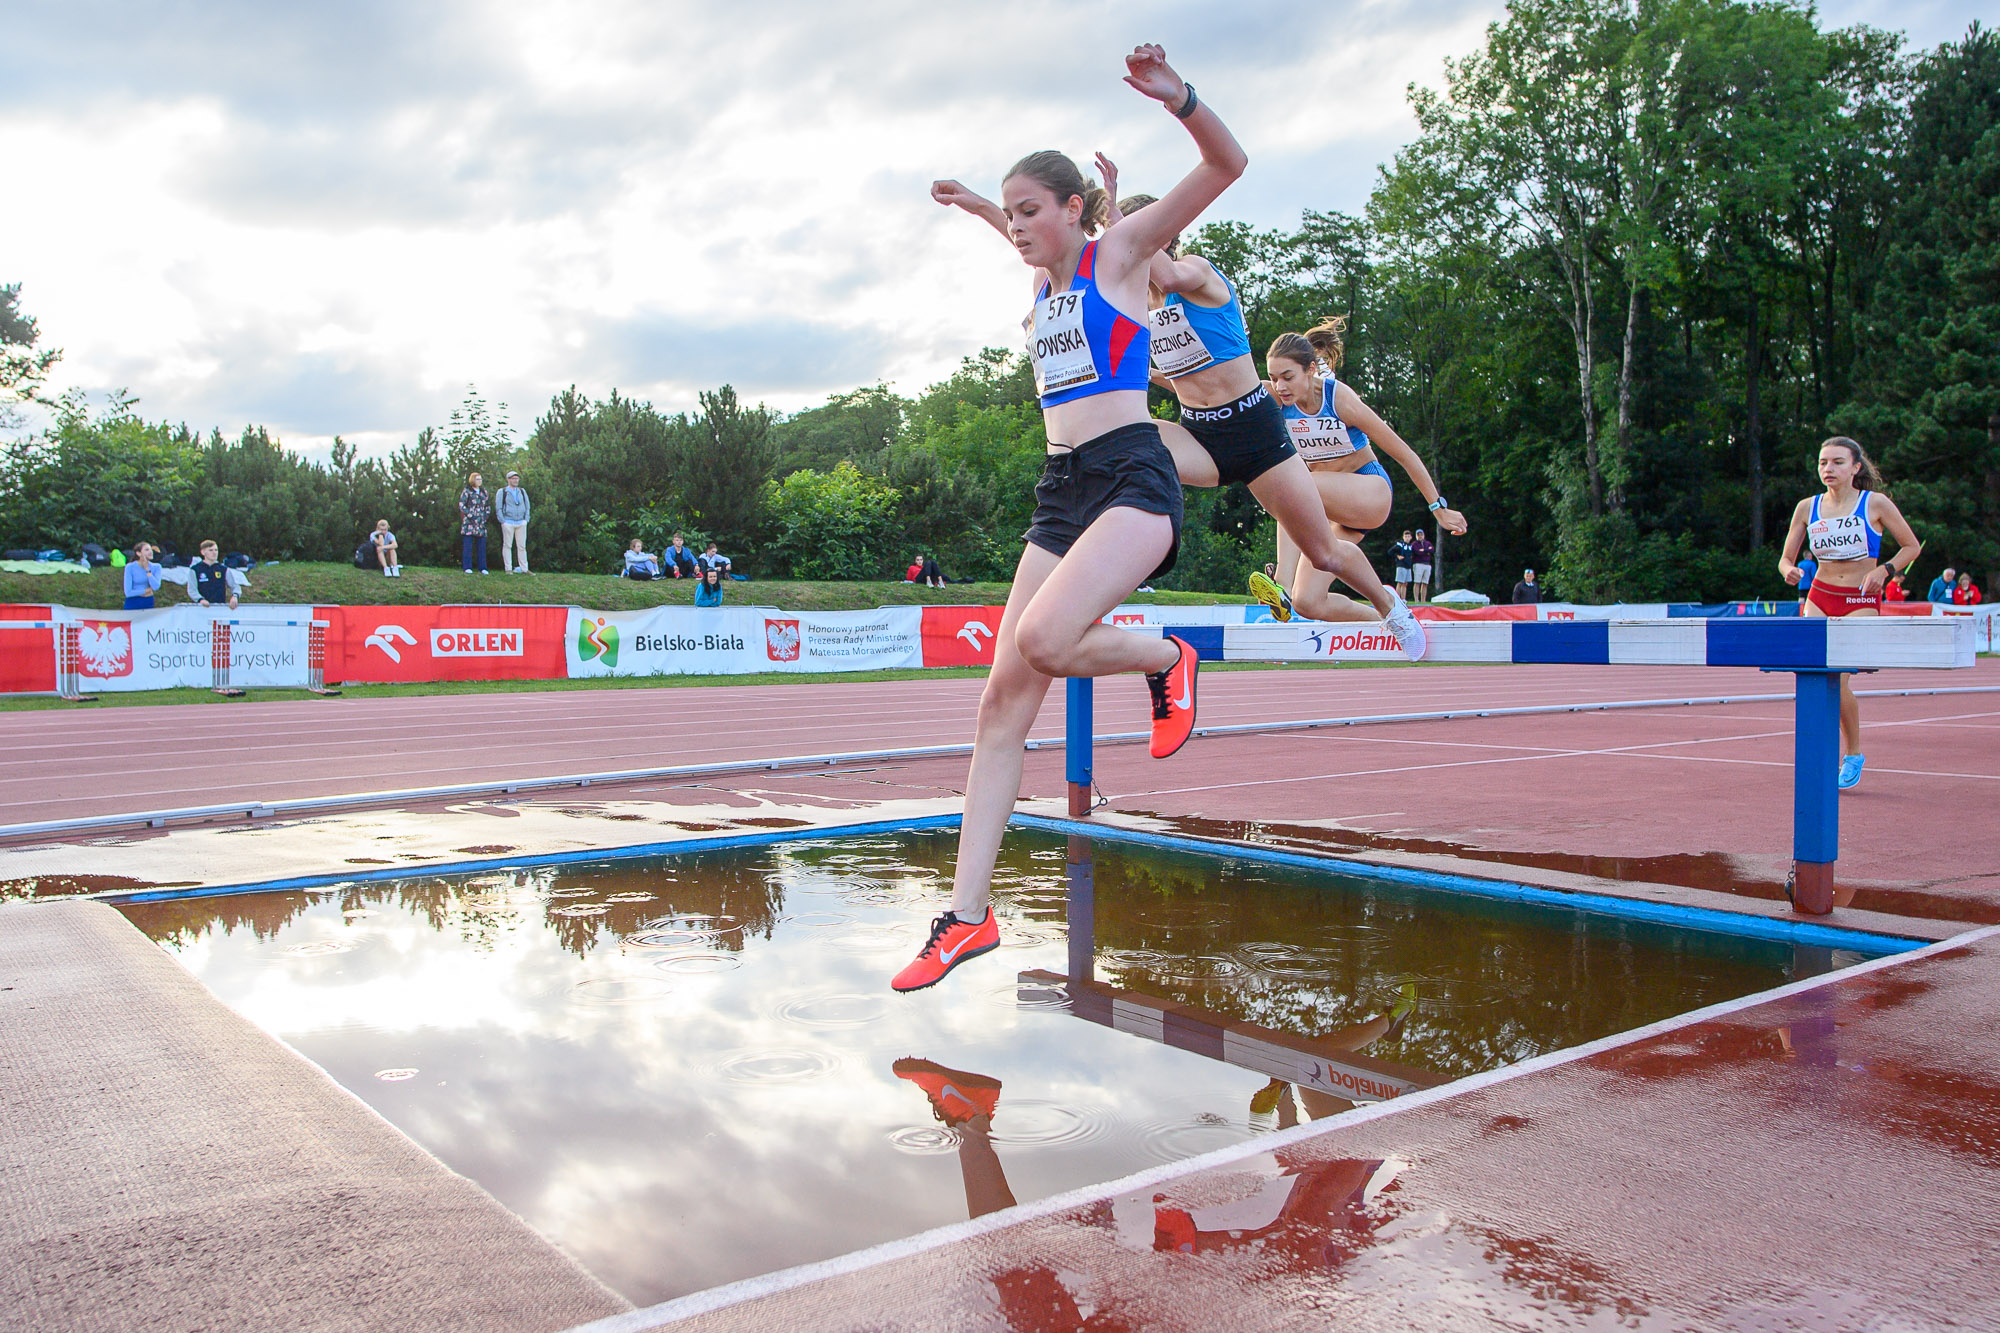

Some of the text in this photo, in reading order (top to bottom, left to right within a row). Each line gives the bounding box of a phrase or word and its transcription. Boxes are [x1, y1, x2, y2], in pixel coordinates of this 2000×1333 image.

[1048, 294, 1078, 320] 579
[1155, 307, 1180, 326] 395
[1034, 328, 1086, 361] OWSKA
[1150, 331, 1197, 355] JECZNICA
[1080, 364, 1094, 373] U18
[1195, 407, 1233, 422] PRO
[1238, 384, 1269, 413] NIKE
[1317, 419, 1341, 430] 721
[1298, 436, 1343, 449] DUTKA
[1836, 516, 1861, 529] 761
[1813, 534, 1862, 549] ŁAŃSKA
[147, 628, 255, 645] Ministerwo
[808, 623, 889, 635] Honorowy patronat
[437, 633, 517, 652] ORLEN
[635, 634, 744, 651] Bielsko-Biała
[808, 632, 908, 645] Prezesa Rady Ministrów
[1329, 631, 1402, 655] polanik
[809, 644, 914, 656] Mateusza Morawieckiego
[148, 653, 205, 671] Sportu
[228, 651, 295, 670] urystyki
